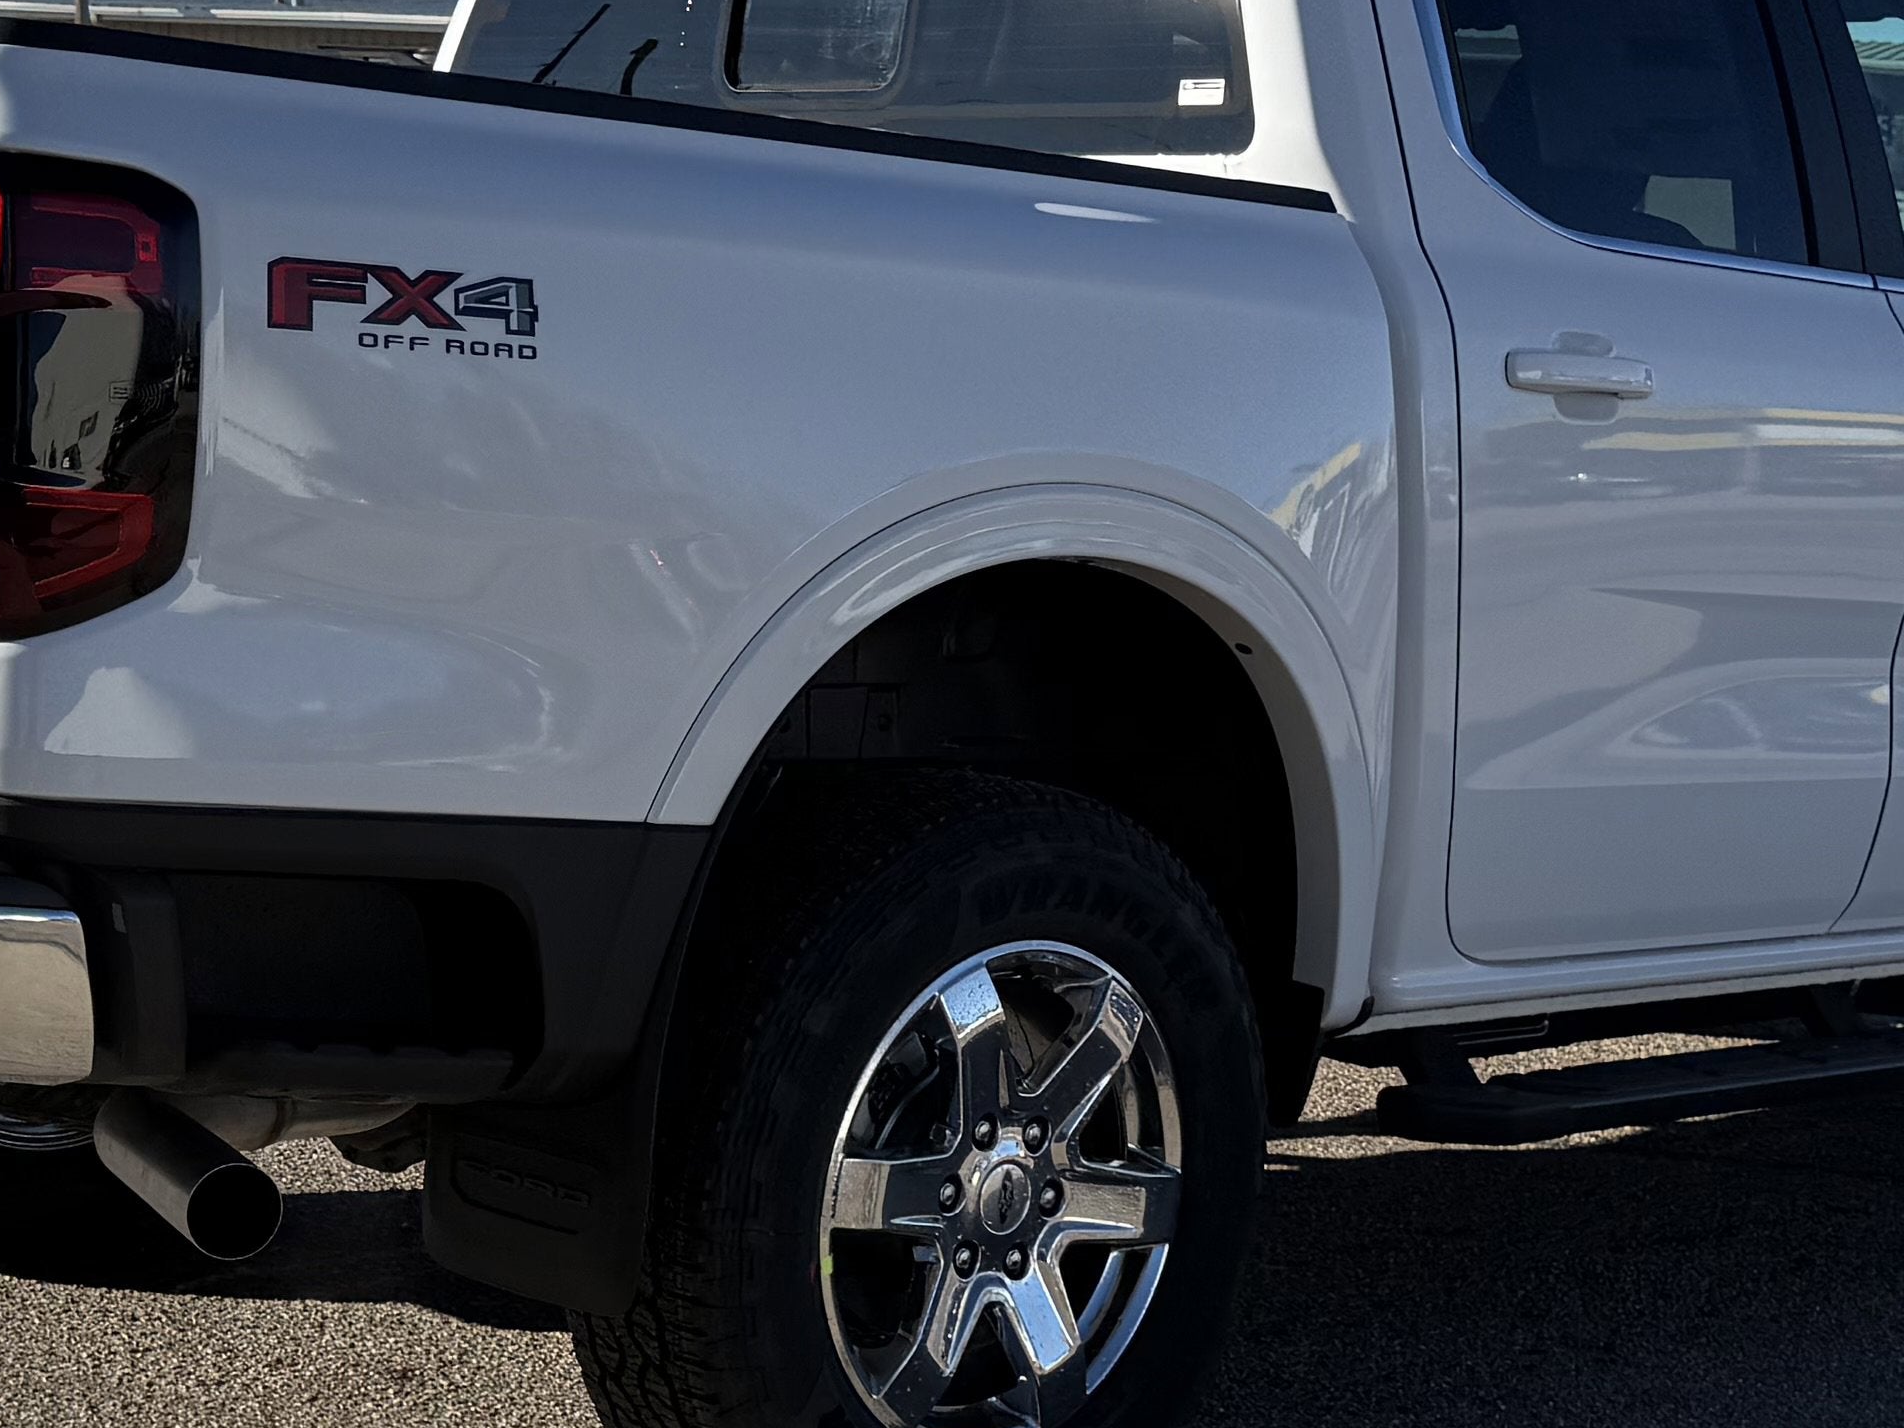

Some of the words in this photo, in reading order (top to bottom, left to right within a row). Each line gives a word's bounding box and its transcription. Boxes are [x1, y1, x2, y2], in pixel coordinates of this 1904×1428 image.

[267, 256, 539, 337] FX4
[358, 332, 430, 352] OFF
[445, 338, 538, 360] ROAD
